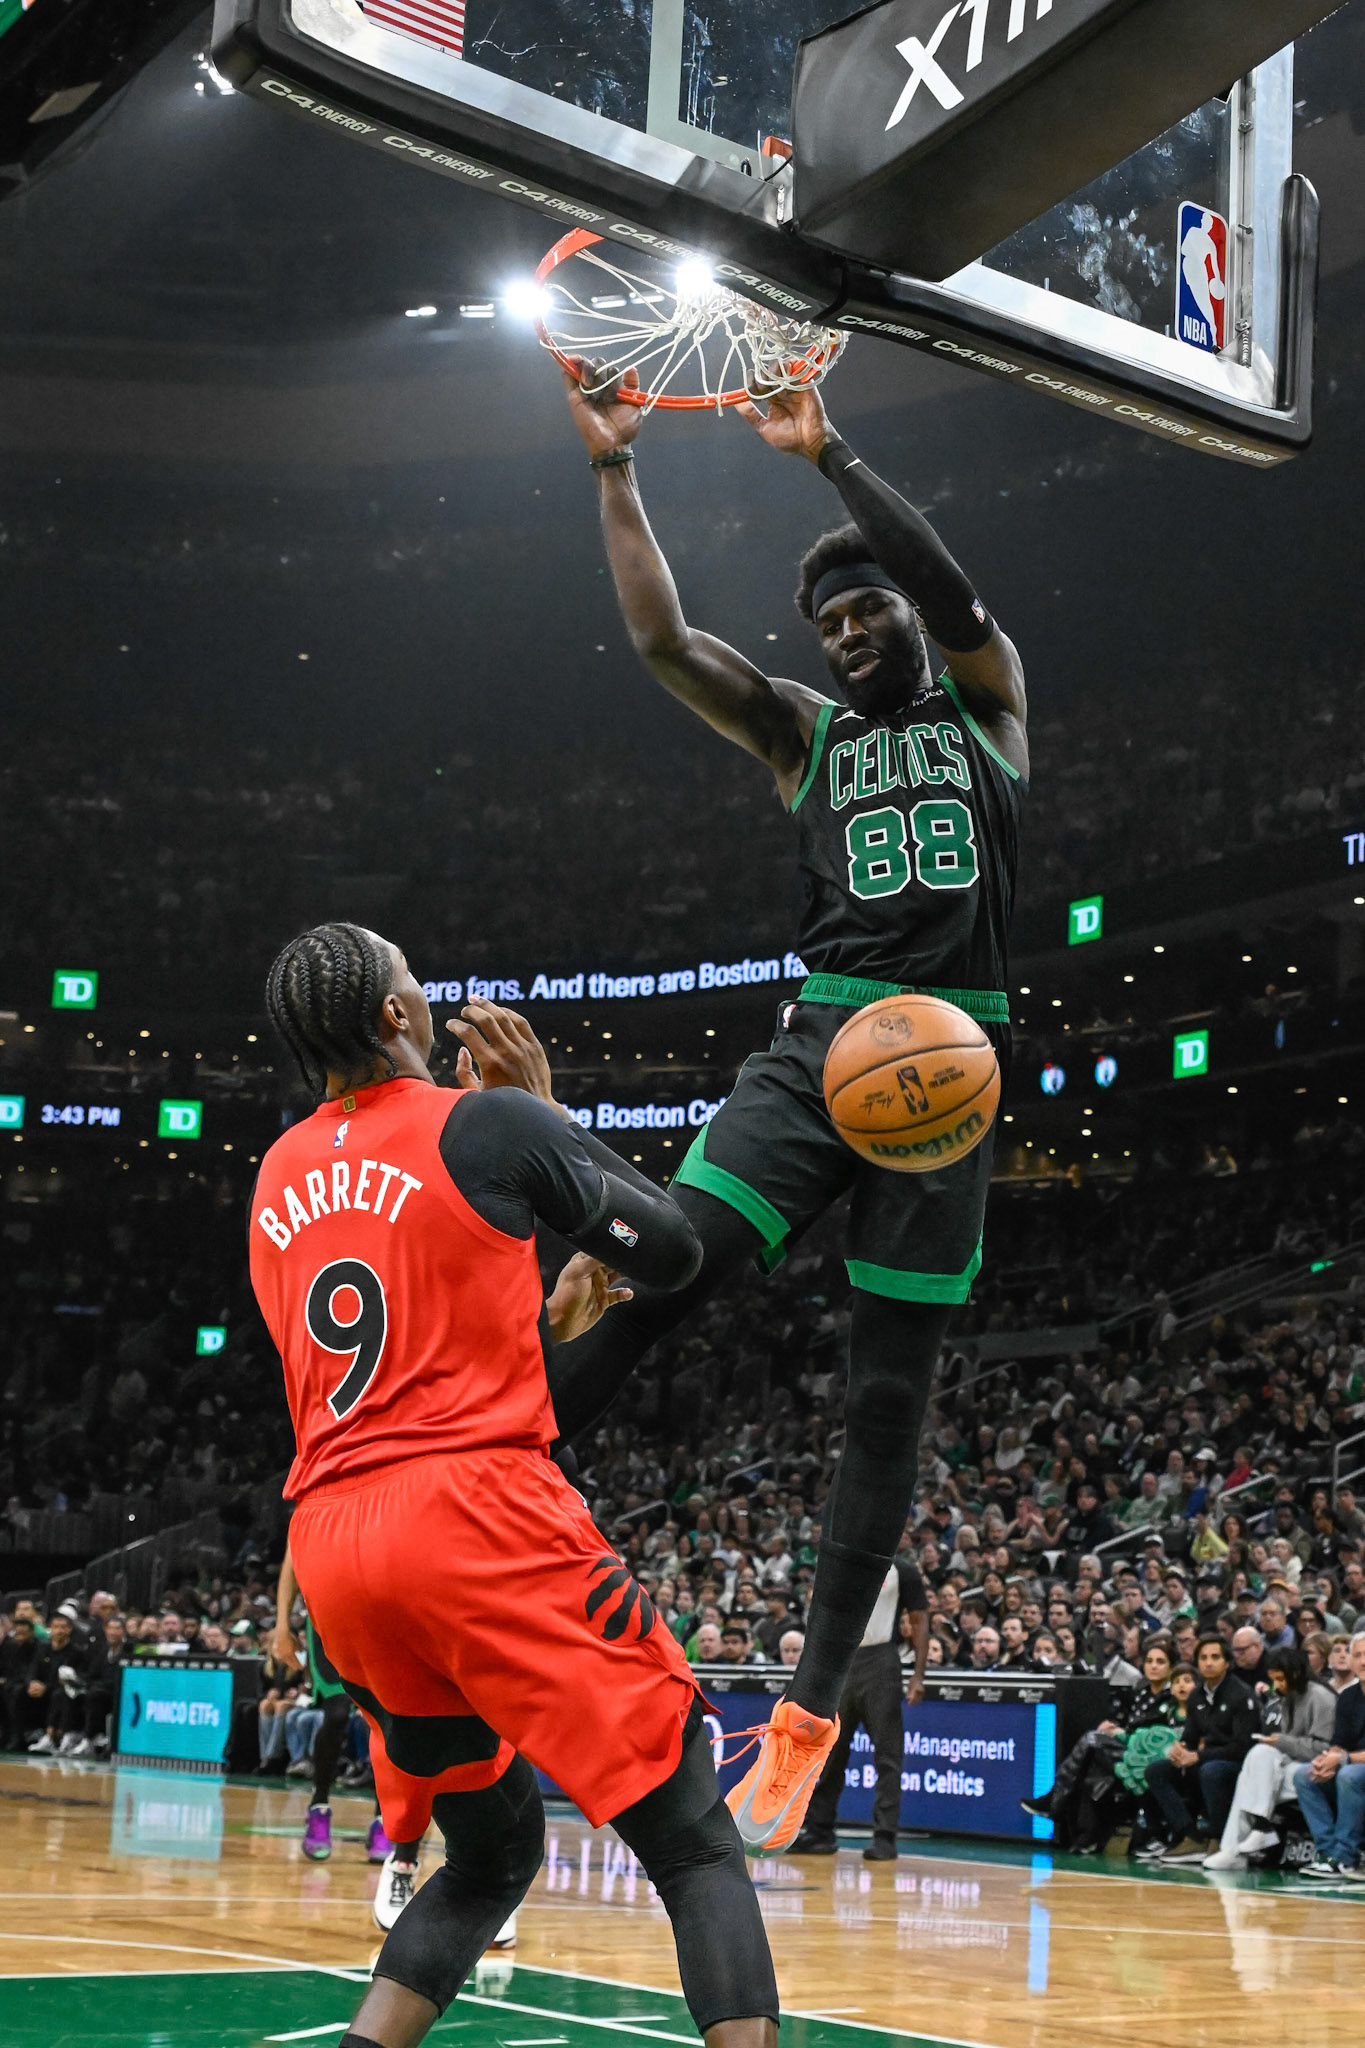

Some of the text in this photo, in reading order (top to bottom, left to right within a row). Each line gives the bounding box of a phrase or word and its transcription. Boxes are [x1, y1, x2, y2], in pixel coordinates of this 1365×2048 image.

[260, 79, 377, 135] C4 ENERGY
[382, 135, 495, 180] C4 ENERGY
[498, 180, 606, 223] C4 ENERGY
[608, 223, 660, 244] C4
[715, 264, 812, 313] C4 ENERGY
[836, 314, 931, 341] C4 ENERGY
[1183, 314, 1208, 346] NBA
[932, 340, 1023, 374] C4 ENERGY
[1024, 373, 1113, 406] C4 ENERGY
[1113, 404, 1198, 437] C4 ENERGY
[1197, 436, 1279, 462] C4 ENERGY
[829, 721, 972, 811] CELTICS
[845, 798, 980, 900] 88
[1072, 904, 1099, 935] TD
[57, 976, 93, 1002] TD
[423, 980, 462, 1002] are
[465, 975, 525, 1001] fans.
[529, 973, 584, 1000] And
[588, 972, 655, 998] there
[657, 969, 695, 995] are
[699, 956, 780, 989] Boston
[1177, 1039, 1205, 1068] TD
[41, 1104, 121, 1126] 3:43 PM
[164, 1106, 197, 1131] TD
[596, 1102, 686, 1130] Boston
[870, 1109, 984, 1158] Wilson
[257, 1158, 423, 1251] BARRETT
[304, 1257, 388, 1422] 9
[903, 1730, 1015, 1763] Management
[923, 1768, 985, 1797] Celtics
